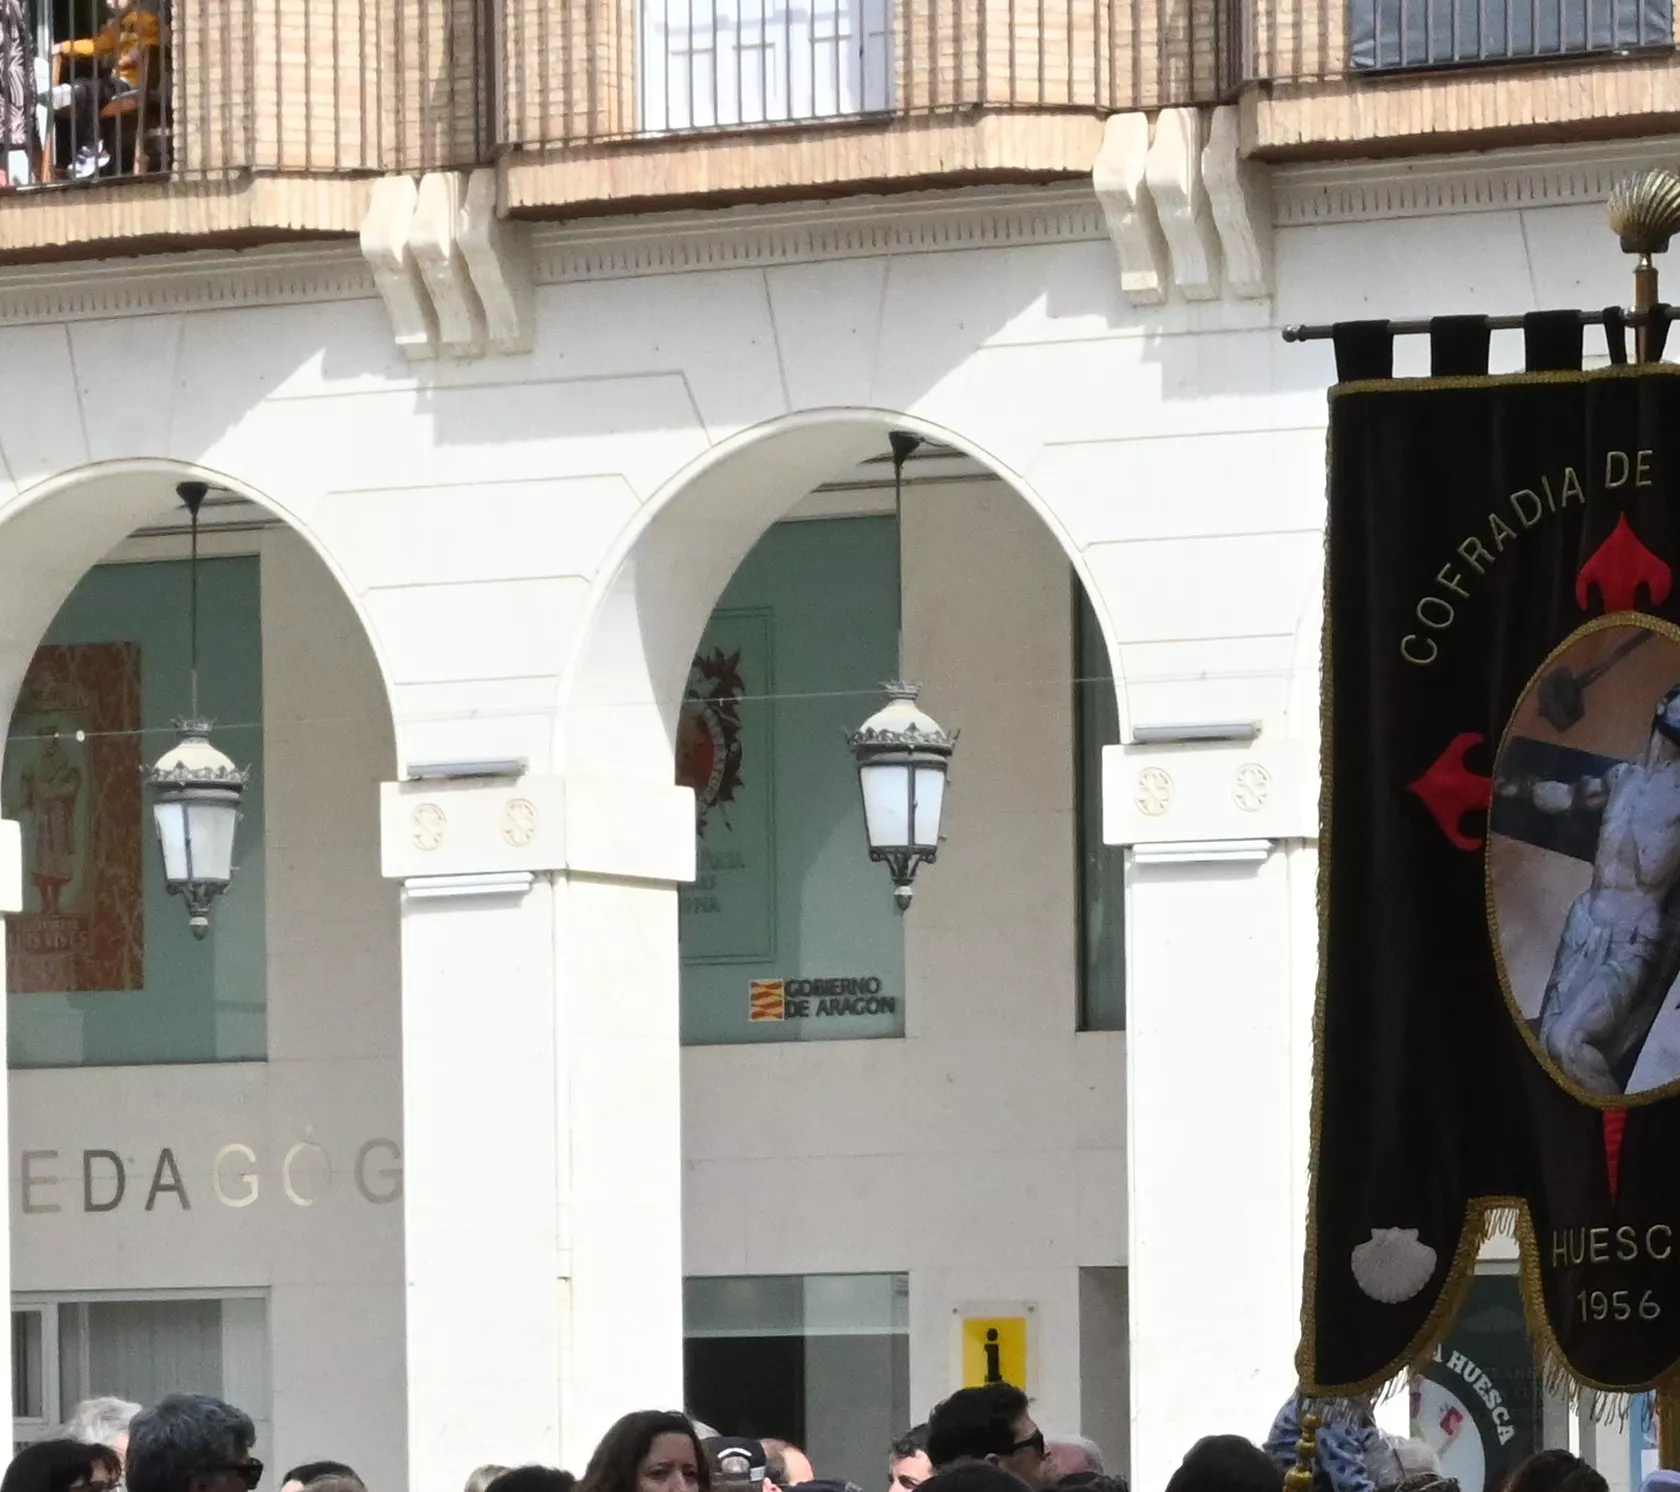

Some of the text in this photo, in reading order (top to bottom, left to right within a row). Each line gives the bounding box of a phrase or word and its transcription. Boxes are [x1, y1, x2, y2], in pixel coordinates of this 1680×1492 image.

[1401, 467, 1586, 665] COFRADIA
[1605, 449, 1654, 489] DE
[784, 976, 881, 998] GOBIERNO
[784, 999, 809, 1017] DE
[1577, 1289, 1662, 1322] 1956
[1445, 1350, 1516, 1446] HUESCA
